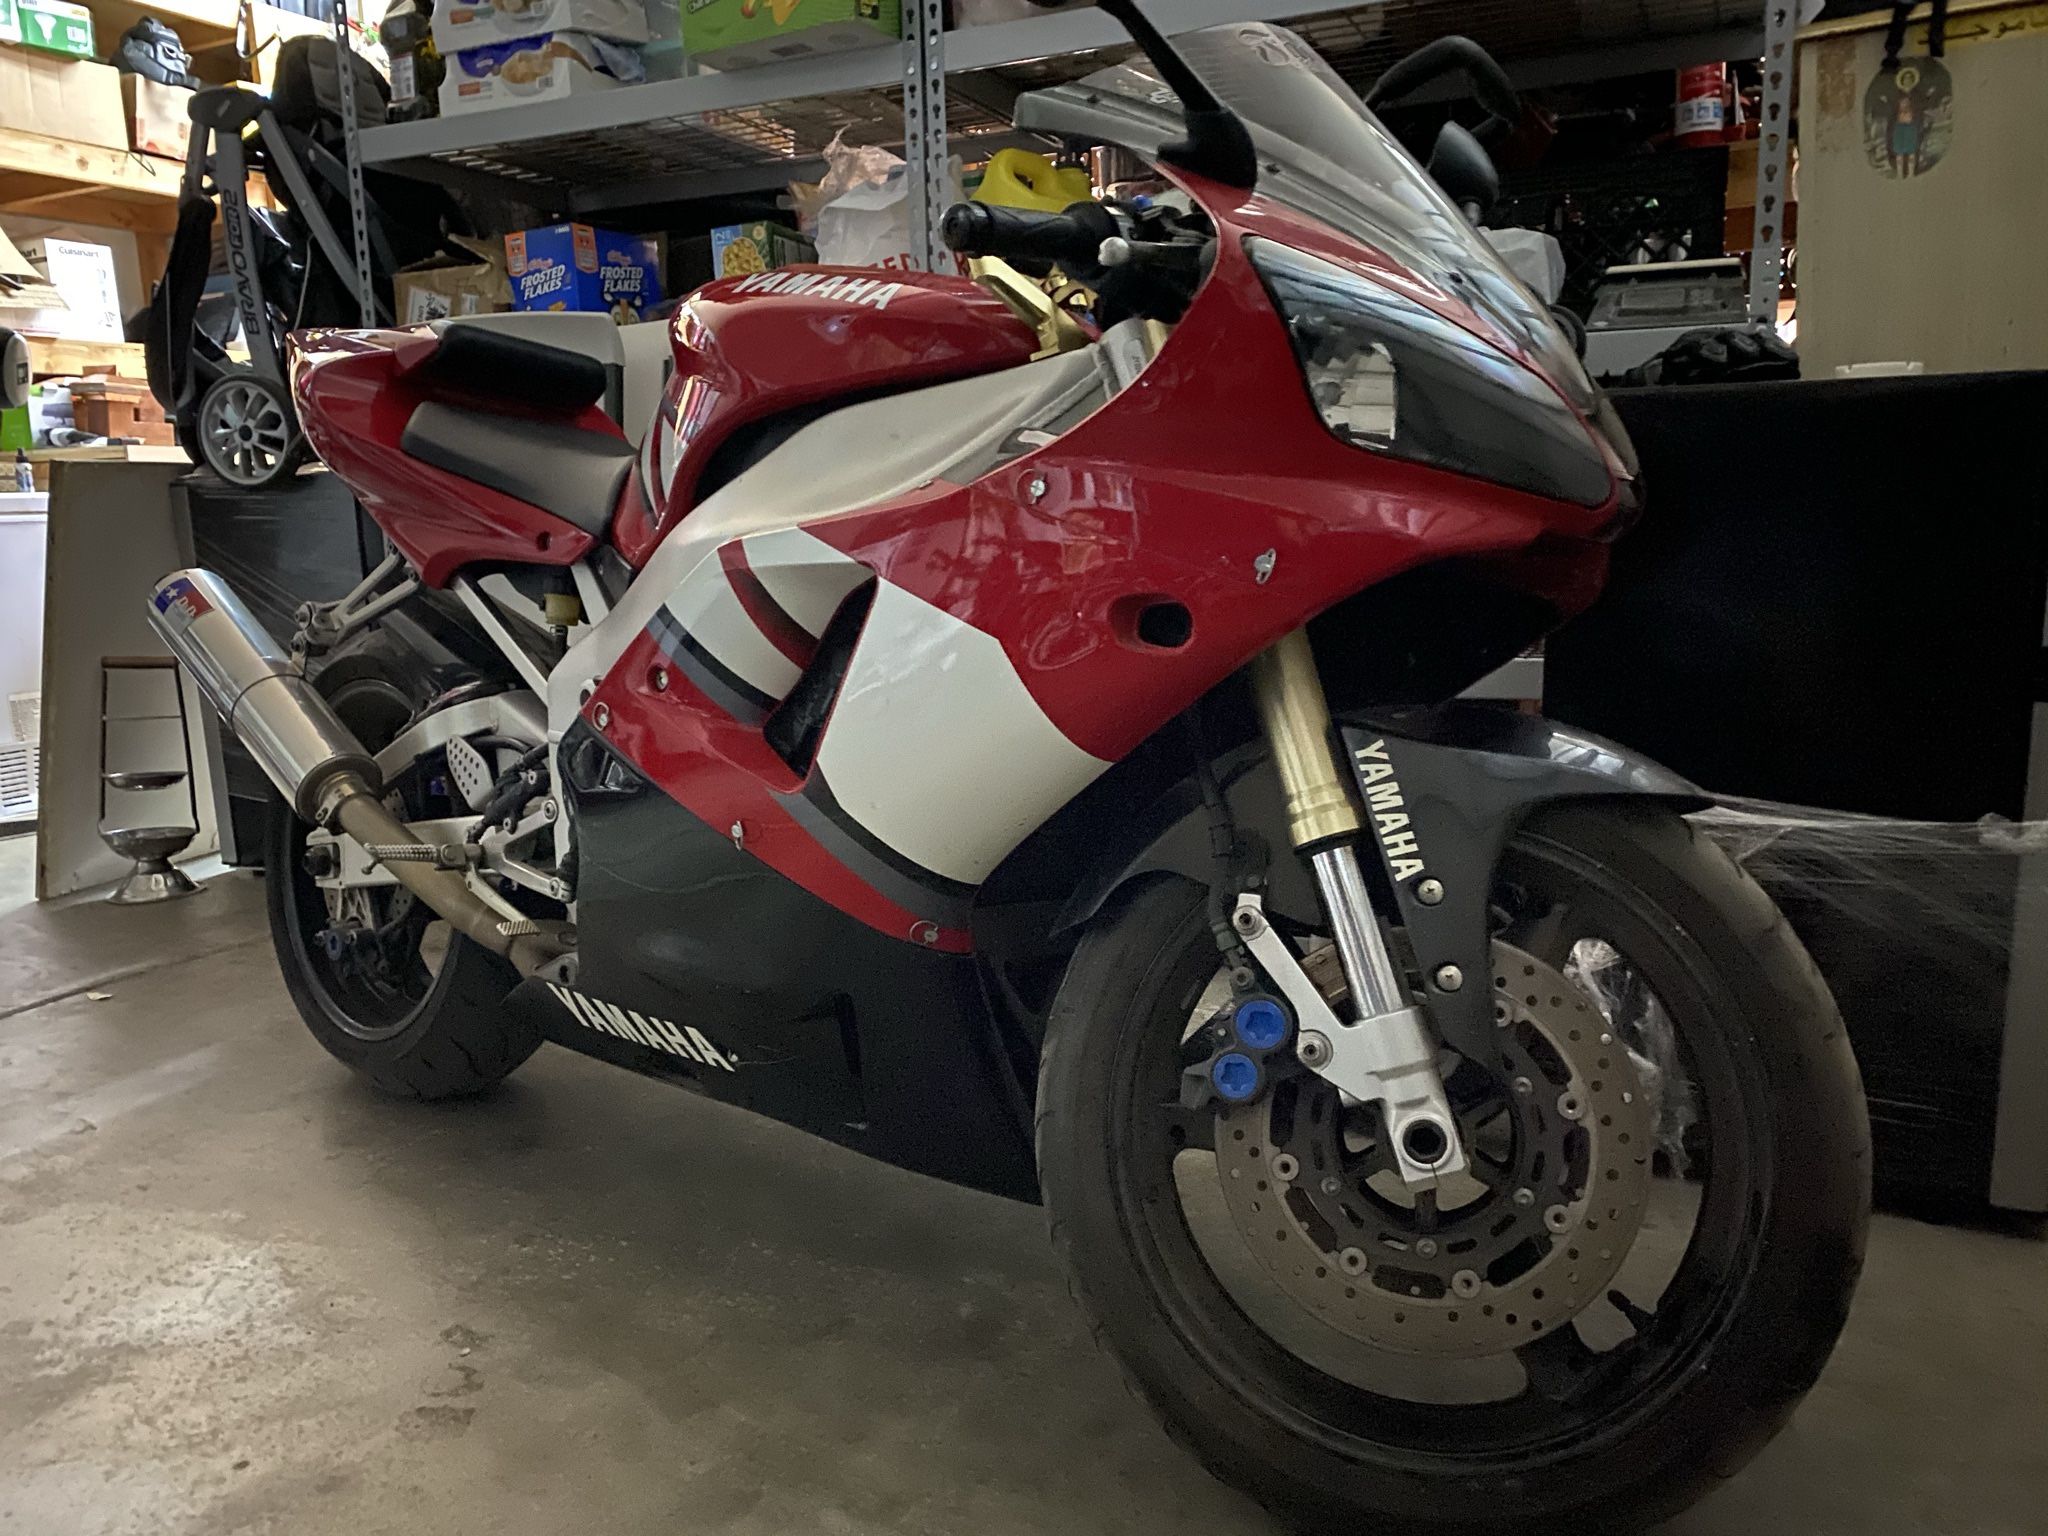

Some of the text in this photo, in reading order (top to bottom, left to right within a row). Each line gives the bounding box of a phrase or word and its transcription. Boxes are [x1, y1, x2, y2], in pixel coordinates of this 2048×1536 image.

[58, 245, 99, 258] Cuisinart
[520, 264, 566, 290] FROSTED
[600, 266, 644, 279] FROSTED
[523, 277, 562, 301] FLAKES
[603, 279, 641, 293] FLAKES
[732, 272, 903, 310] YAMAHA
[1354, 738, 1425, 882] YAMAHA
[546, 981, 735, 1072] YAMAHA
